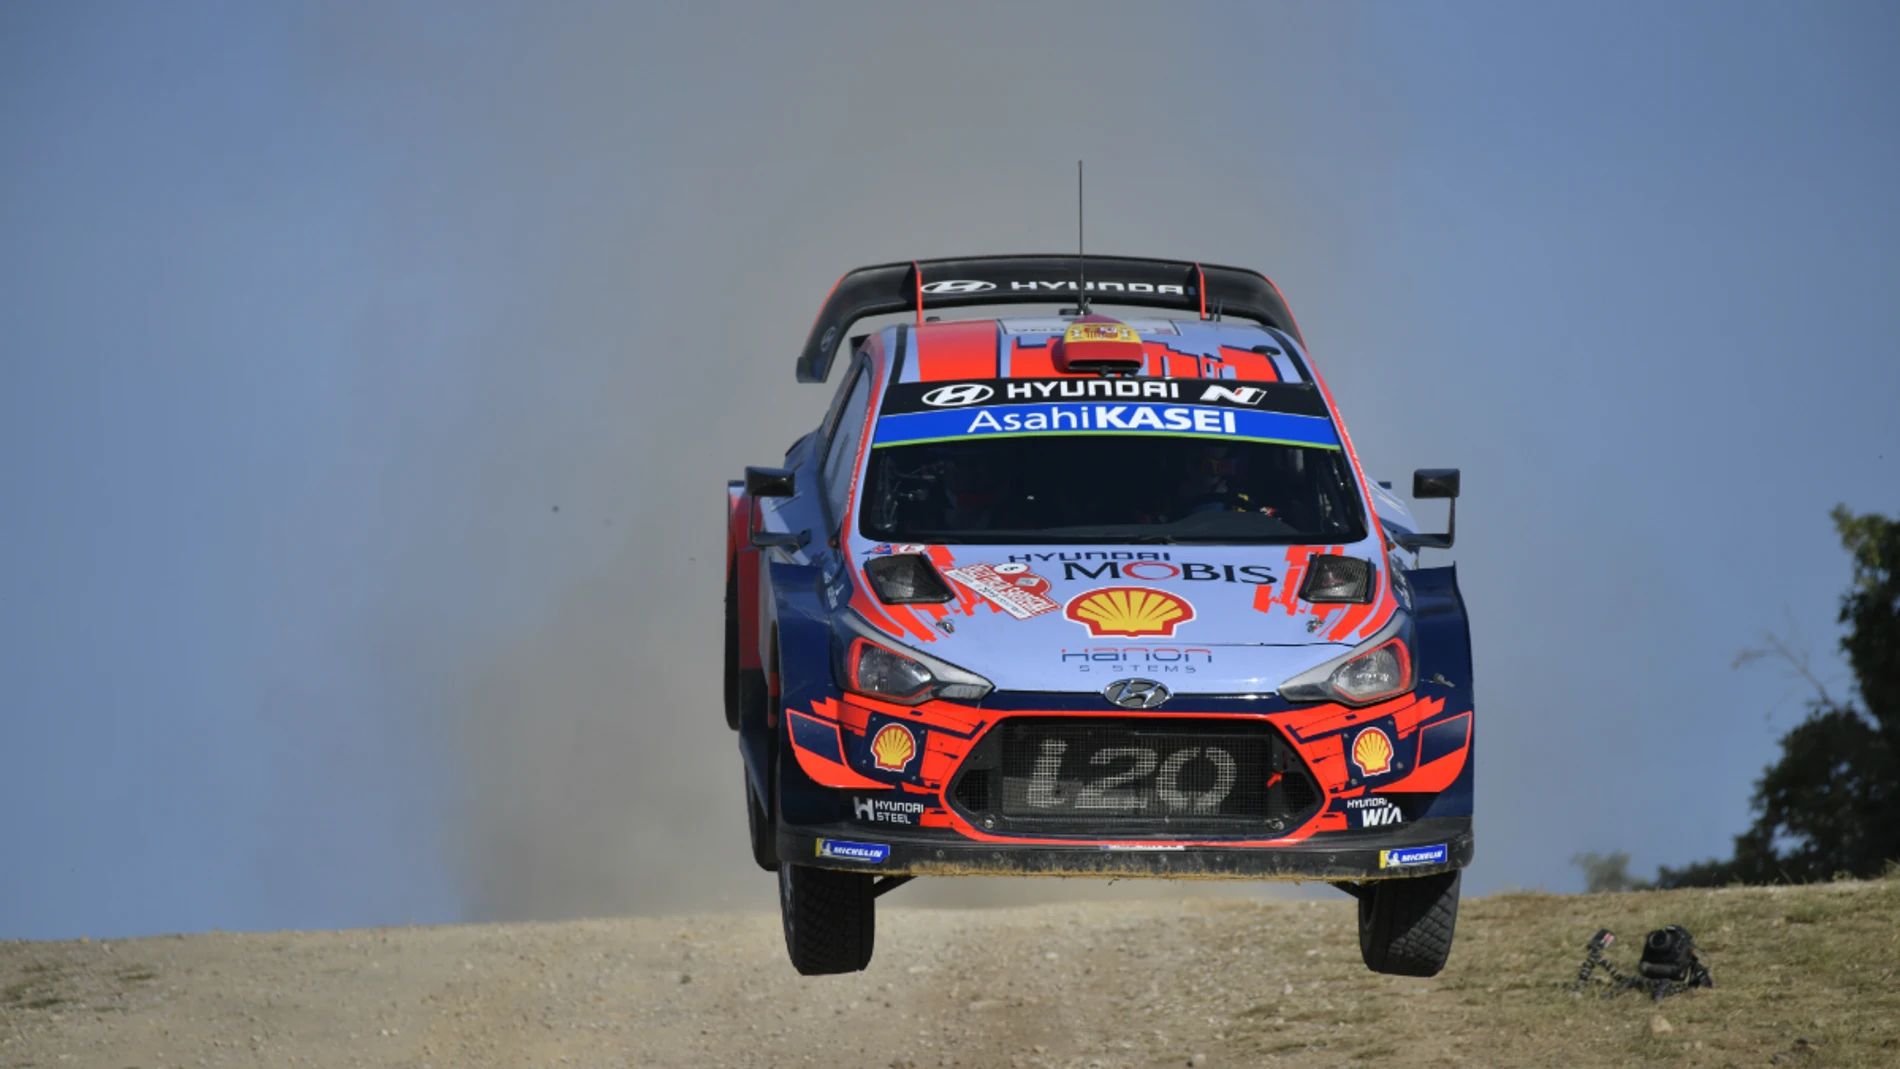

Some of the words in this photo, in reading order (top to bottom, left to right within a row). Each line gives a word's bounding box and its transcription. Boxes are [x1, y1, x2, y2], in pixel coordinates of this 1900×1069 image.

[1007, 380, 1179, 399] HYUNDAI
[1008, 551, 1171, 563] HYUNDAI
[1063, 560, 1278, 585] MOBIS
[1079, 664, 1196, 674] SSTEMS
[875, 800, 924, 813] HYUNDAI
[876, 811, 911, 824] STEEL
[1362, 802, 1402, 828] WIA
[833, 846, 883, 858] MICHELIN
[1401, 850, 1443, 863] MICHELIN
